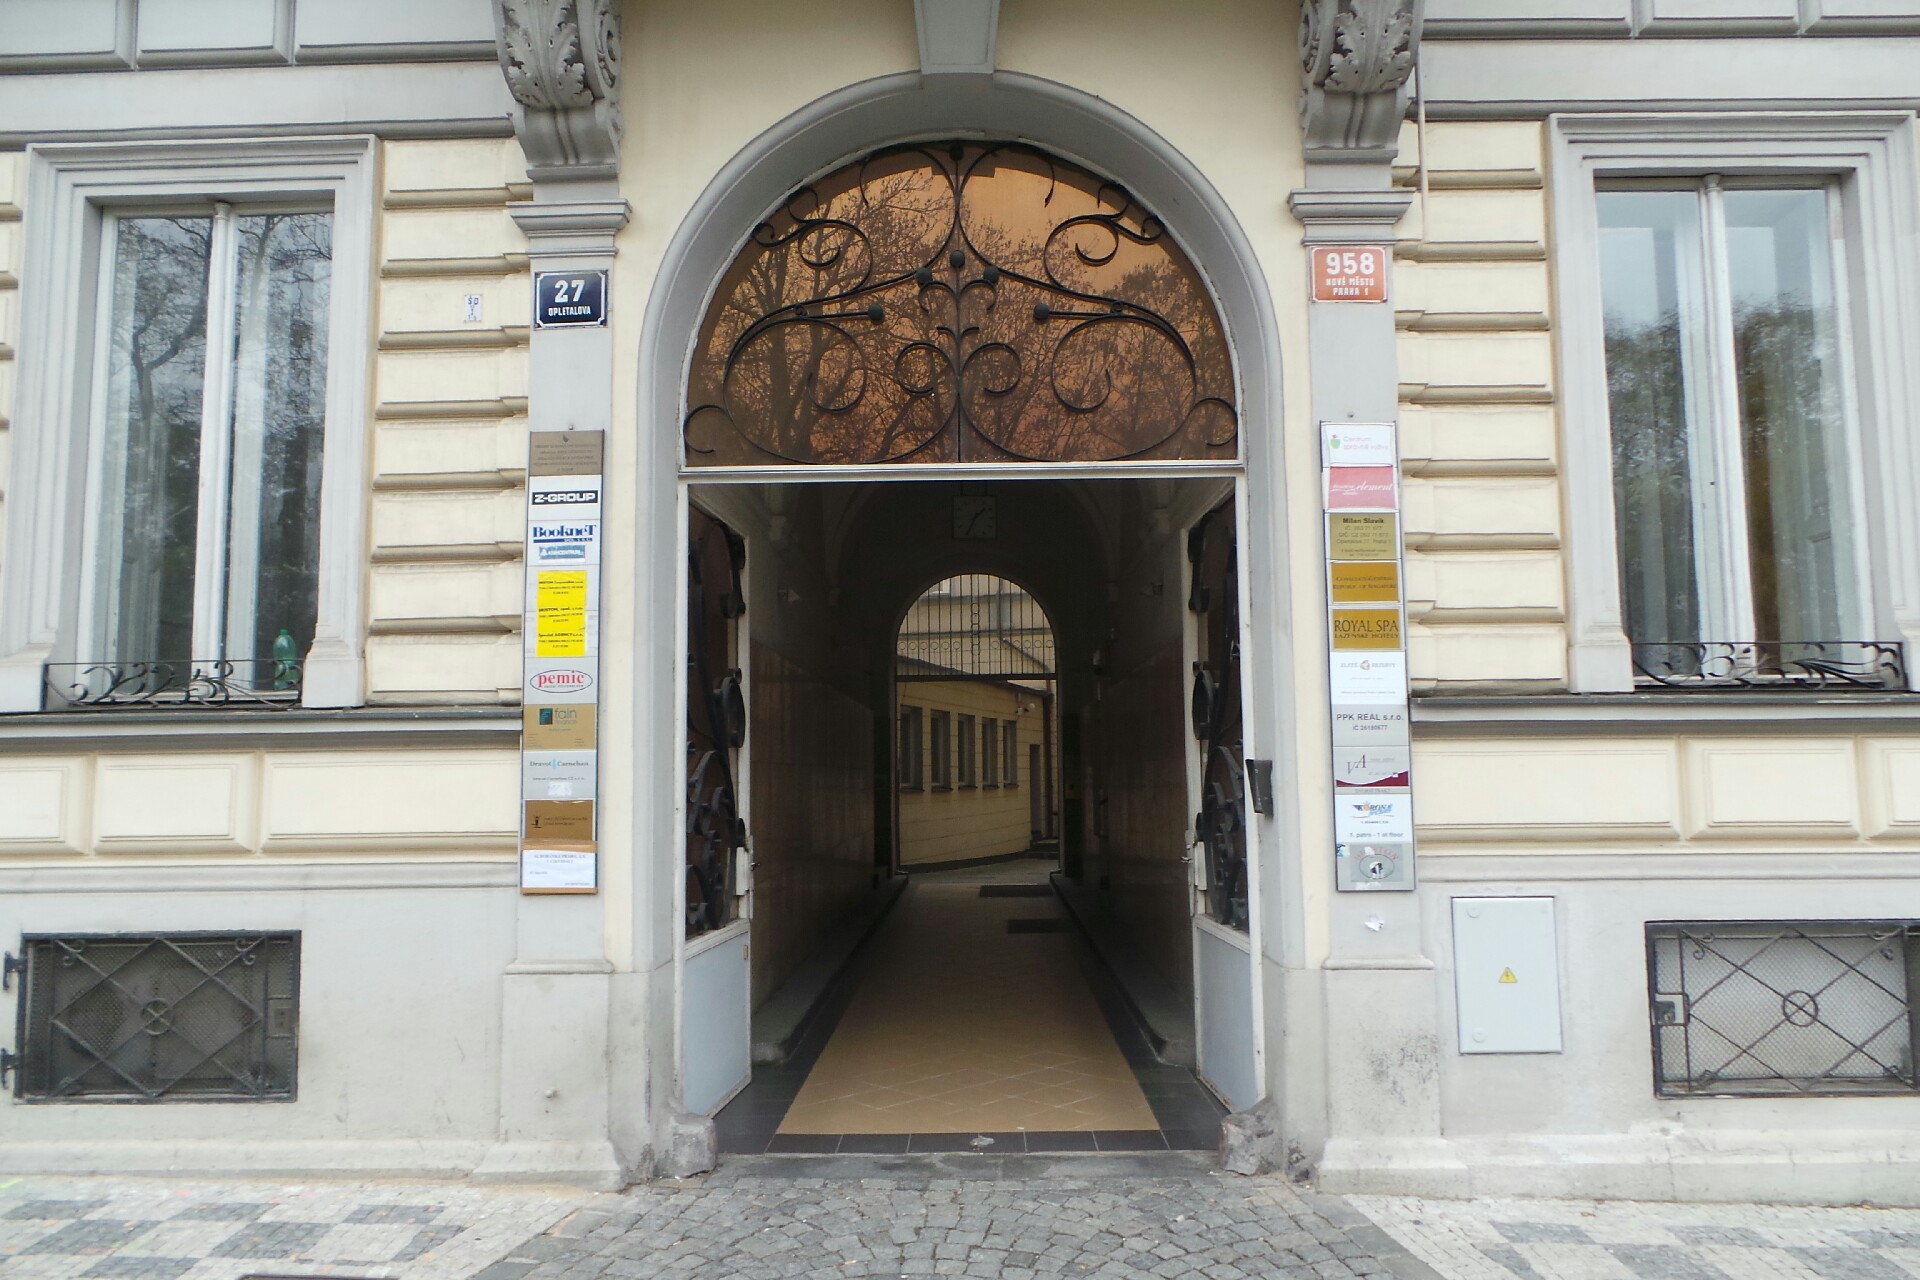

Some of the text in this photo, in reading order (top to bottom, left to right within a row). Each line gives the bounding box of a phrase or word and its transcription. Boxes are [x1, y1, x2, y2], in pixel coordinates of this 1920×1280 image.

[1326, 252, 1374, 275] 958
[1326, 276, 1374, 286] NOVÉ MĚSTO
[554, 279, 585, 303] 27
[1333, 287, 1360, 296] PRAHA
[548, 305, 591, 317] OPLETALOVA
[534, 492, 596, 503] Z-GROUP
[1334, 619, 1399, 632] ROYAL SPA
[537, 669, 584, 688] pemic
[554, 707, 577, 719] fain
[1336, 713, 1355, 721] PPK
[1357, 713, 1381, 721] REAL
